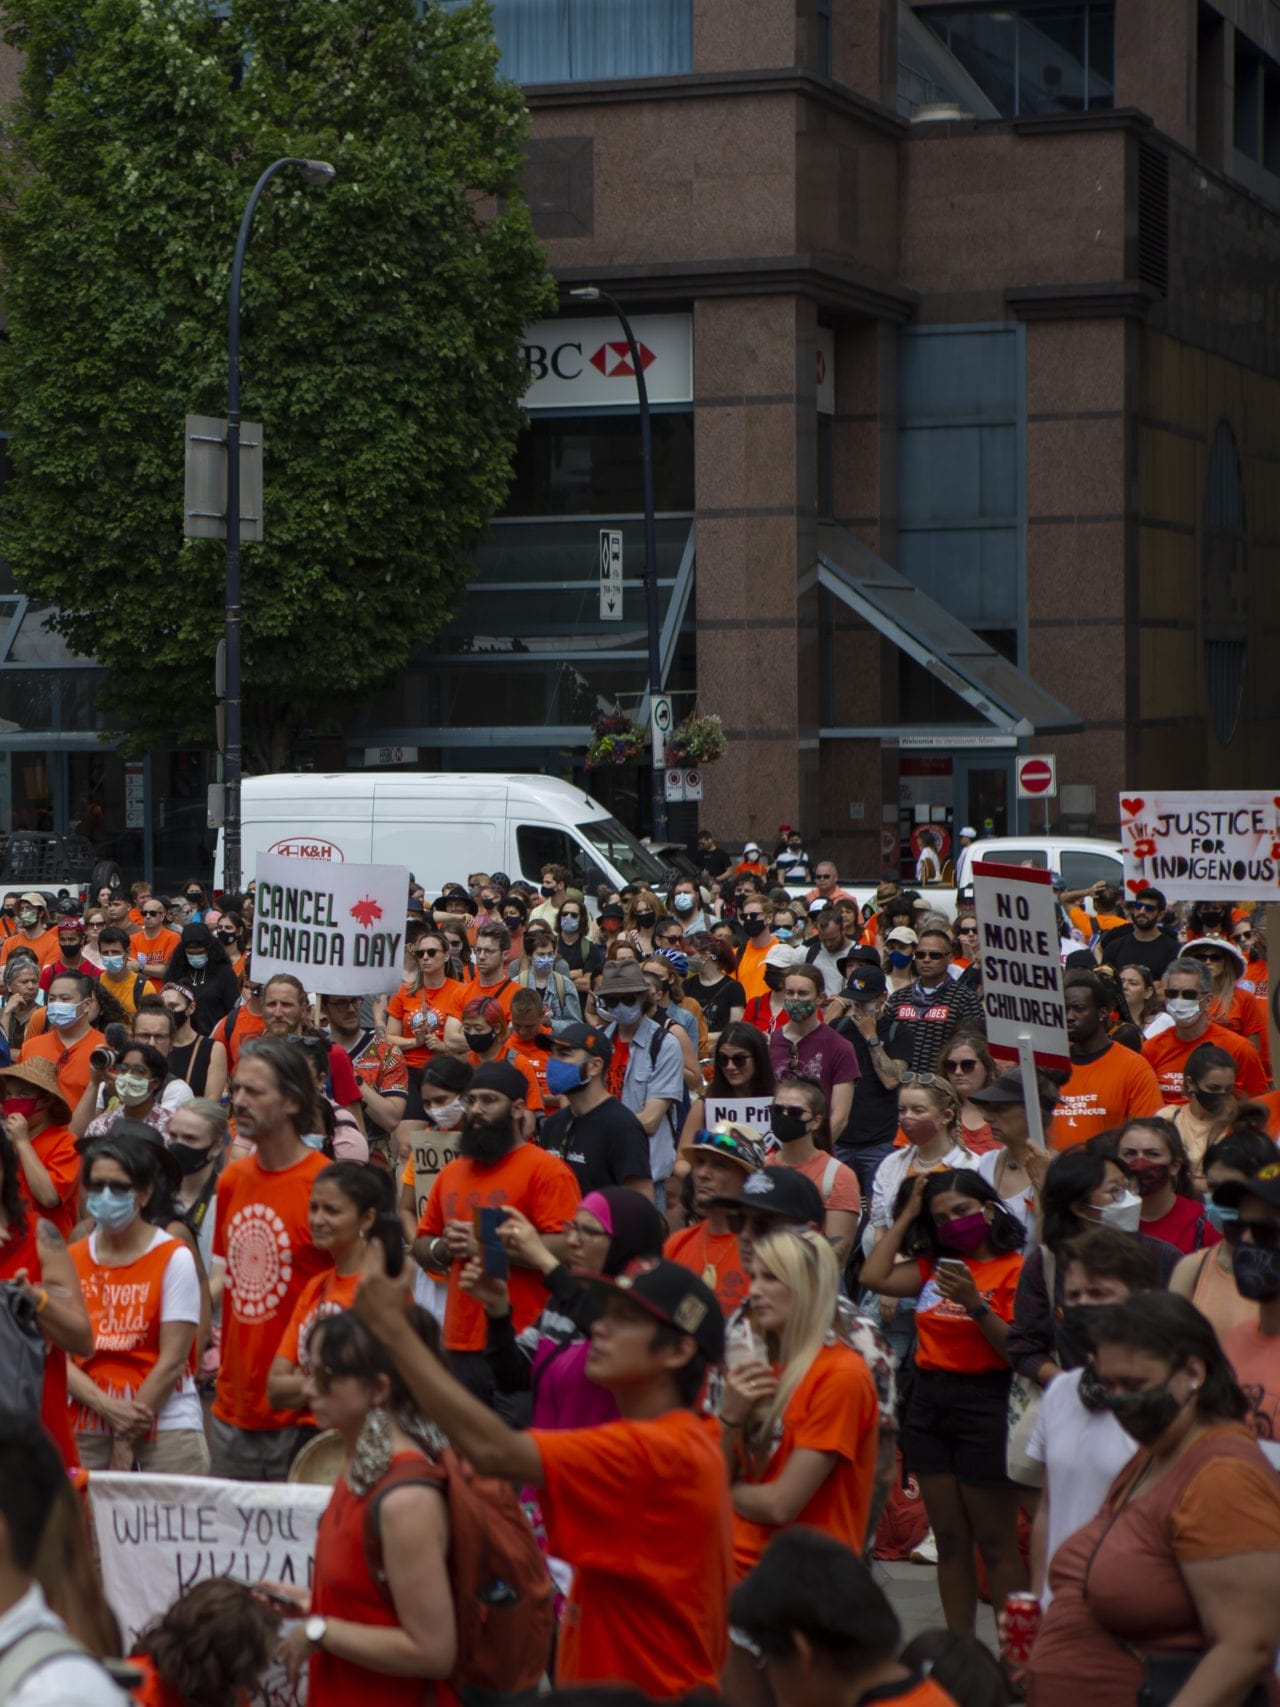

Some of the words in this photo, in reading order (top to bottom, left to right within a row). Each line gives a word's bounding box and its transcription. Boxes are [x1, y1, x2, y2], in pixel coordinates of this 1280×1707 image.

[523, 342, 583, 381] BC
[901, 737, 934, 745] Welcome
[127, 776, 134, 785] 3
[127, 788, 134, 797] 2
[127, 812, 135, 821] C
[128, 800, 133, 809] 1
[1156, 809, 1269, 837] JUSTICE
[300, 845, 332, 858] K&H
[1190, 838, 1225, 854] FOR
[1151, 855, 1274, 882] INDIGENOUS
[257, 882, 338, 928] CANCEL
[996, 892, 1030, 921] NO
[256, 922, 345, 966] CANADA
[353, 933, 402, 967] DAY
[984, 922, 1050, 957] MORE
[985, 955, 1058, 992] STOLEN
[899, 1007, 916, 1018] GOO
[985, 992, 1066, 1030] CHILDREN
[715, 1107, 737, 1123] No
[745, 1107, 769, 1123] Pri
[103, 1281, 151, 1307] every
[99, 1306, 150, 1334] child
[113, 1506, 218, 1545] WHILE
[237, 1507, 300, 1547] YOU
